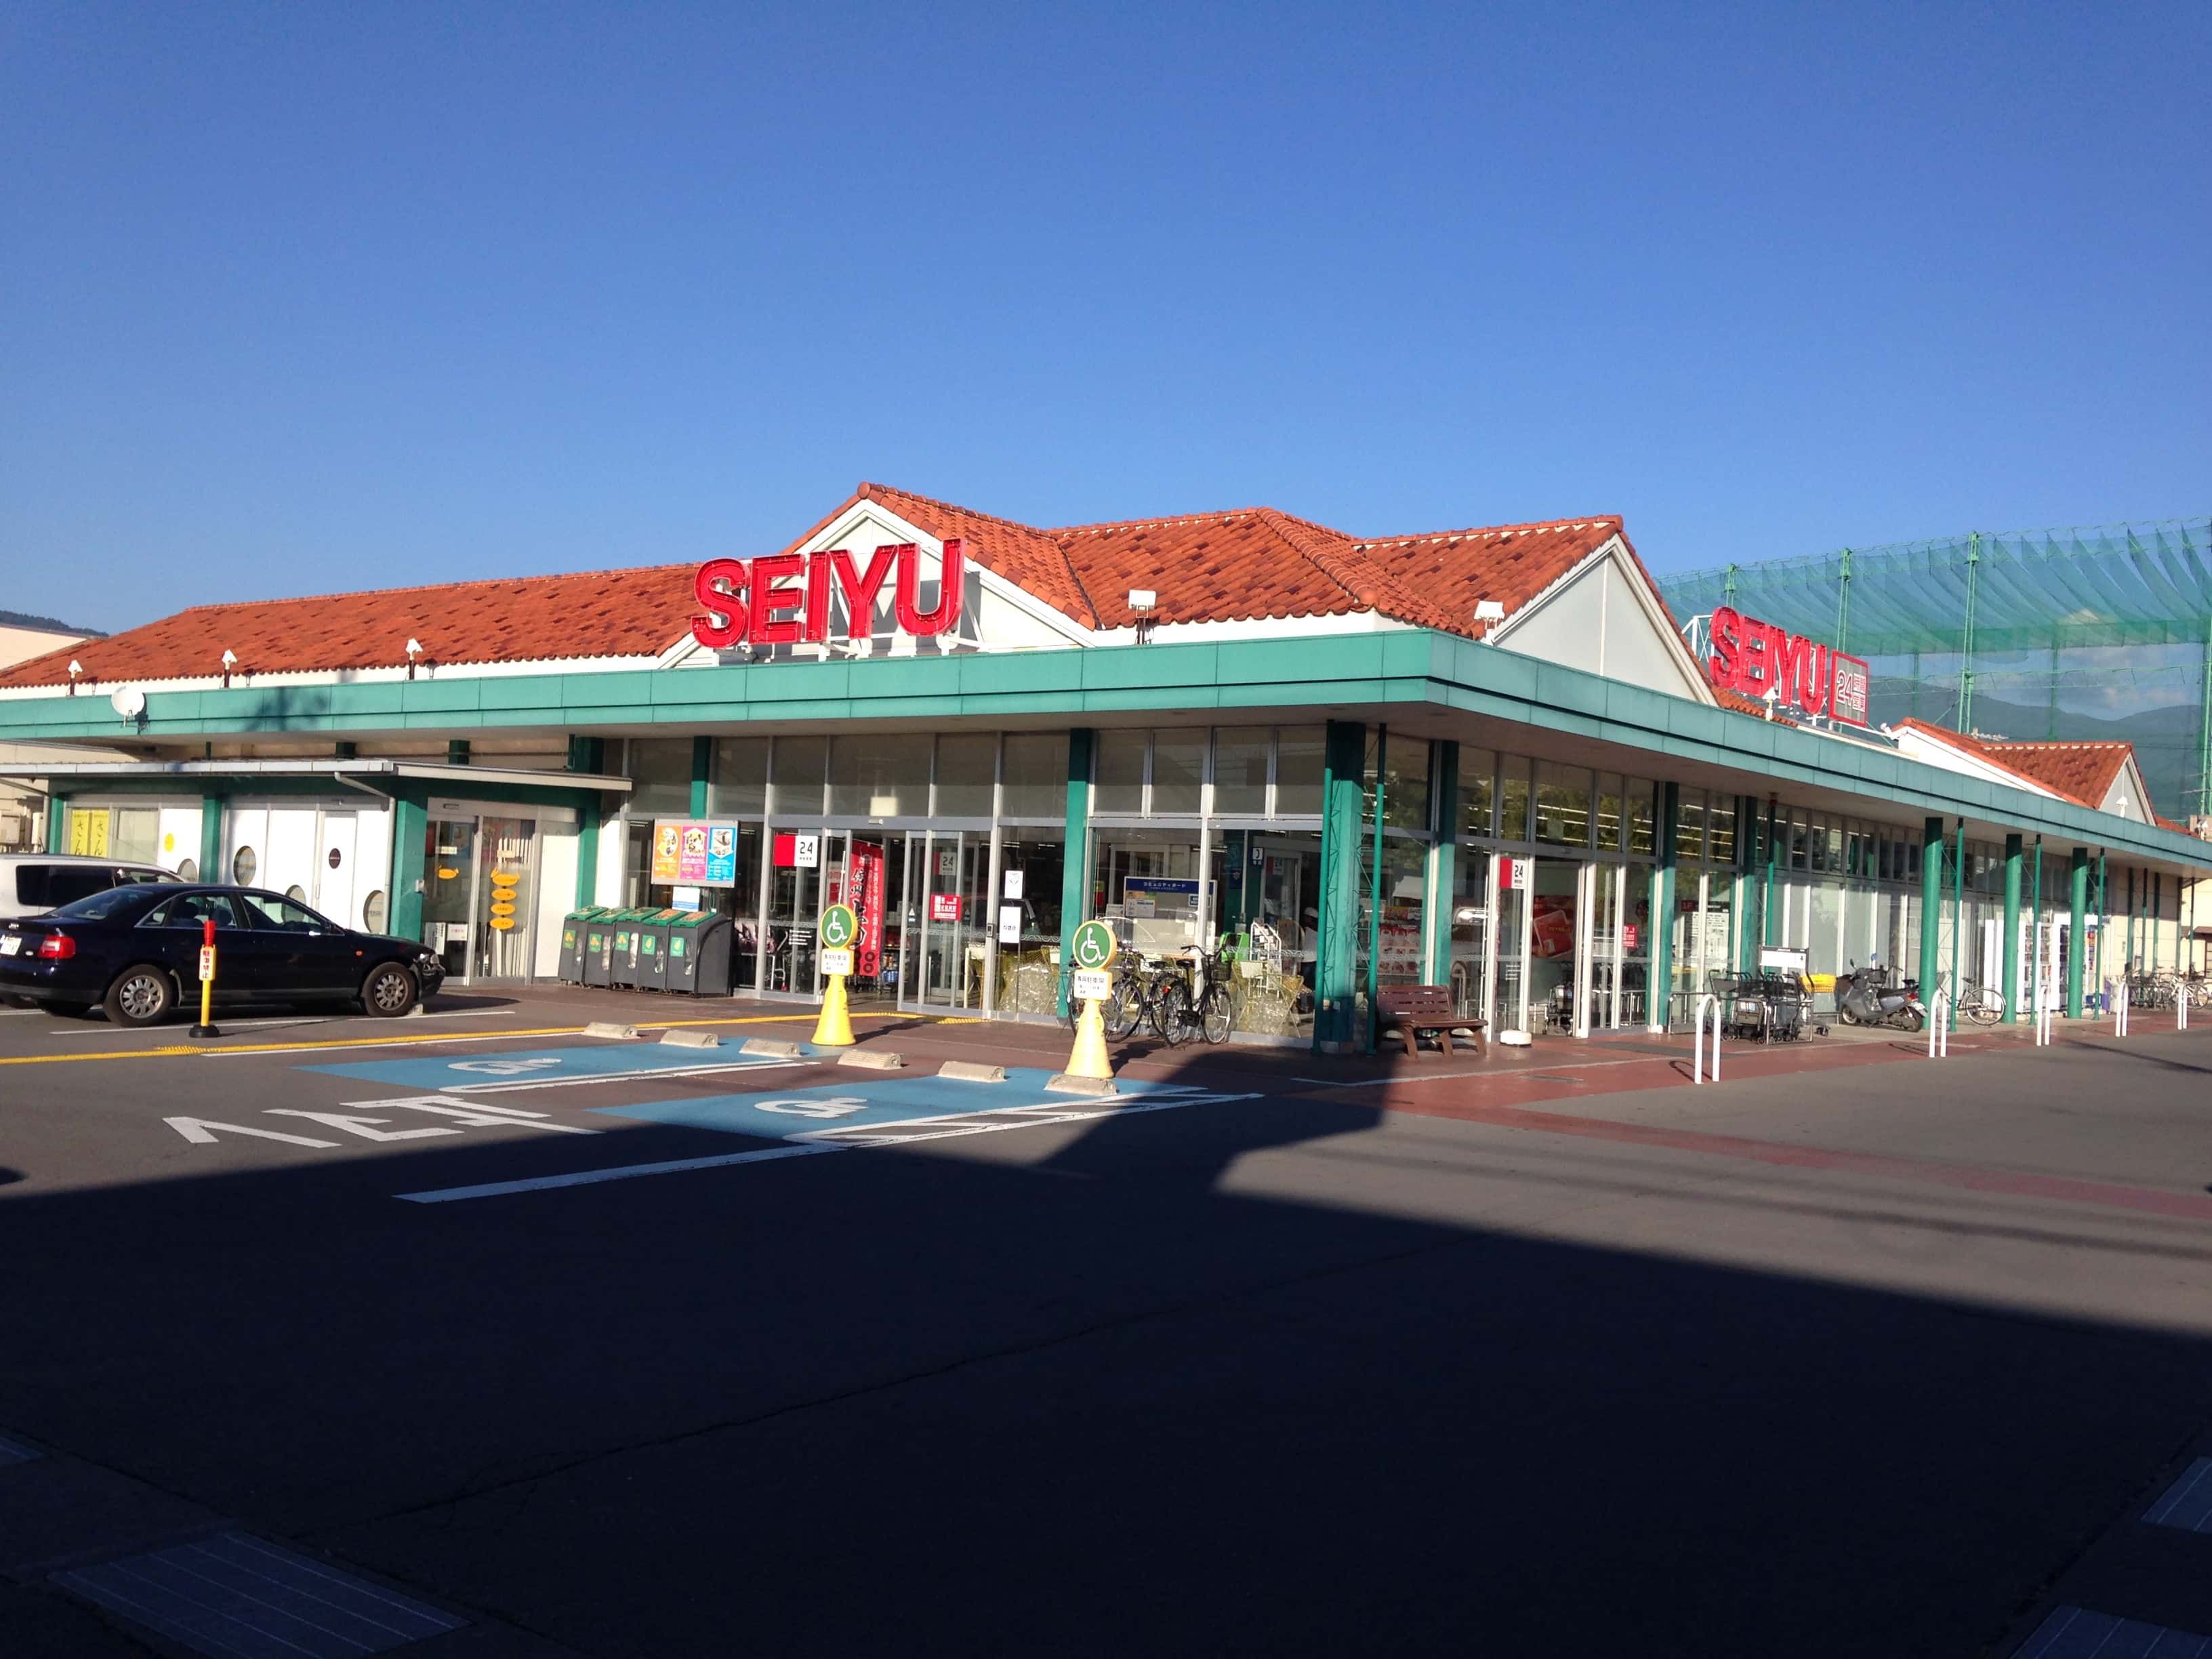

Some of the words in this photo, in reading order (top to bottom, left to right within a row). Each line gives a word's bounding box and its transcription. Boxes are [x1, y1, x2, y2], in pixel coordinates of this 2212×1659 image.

[691, 537, 966, 649] SEIYU
[1708, 607, 1827, 714] SEIYU
[1836, 670, 1853, 706] 24
[1853, 672, 1866, 694] 時間
[800, 842, 813, 855] 24
[943, 856, 954, 867] 24
[1515, 865, 1523, 878] 24
